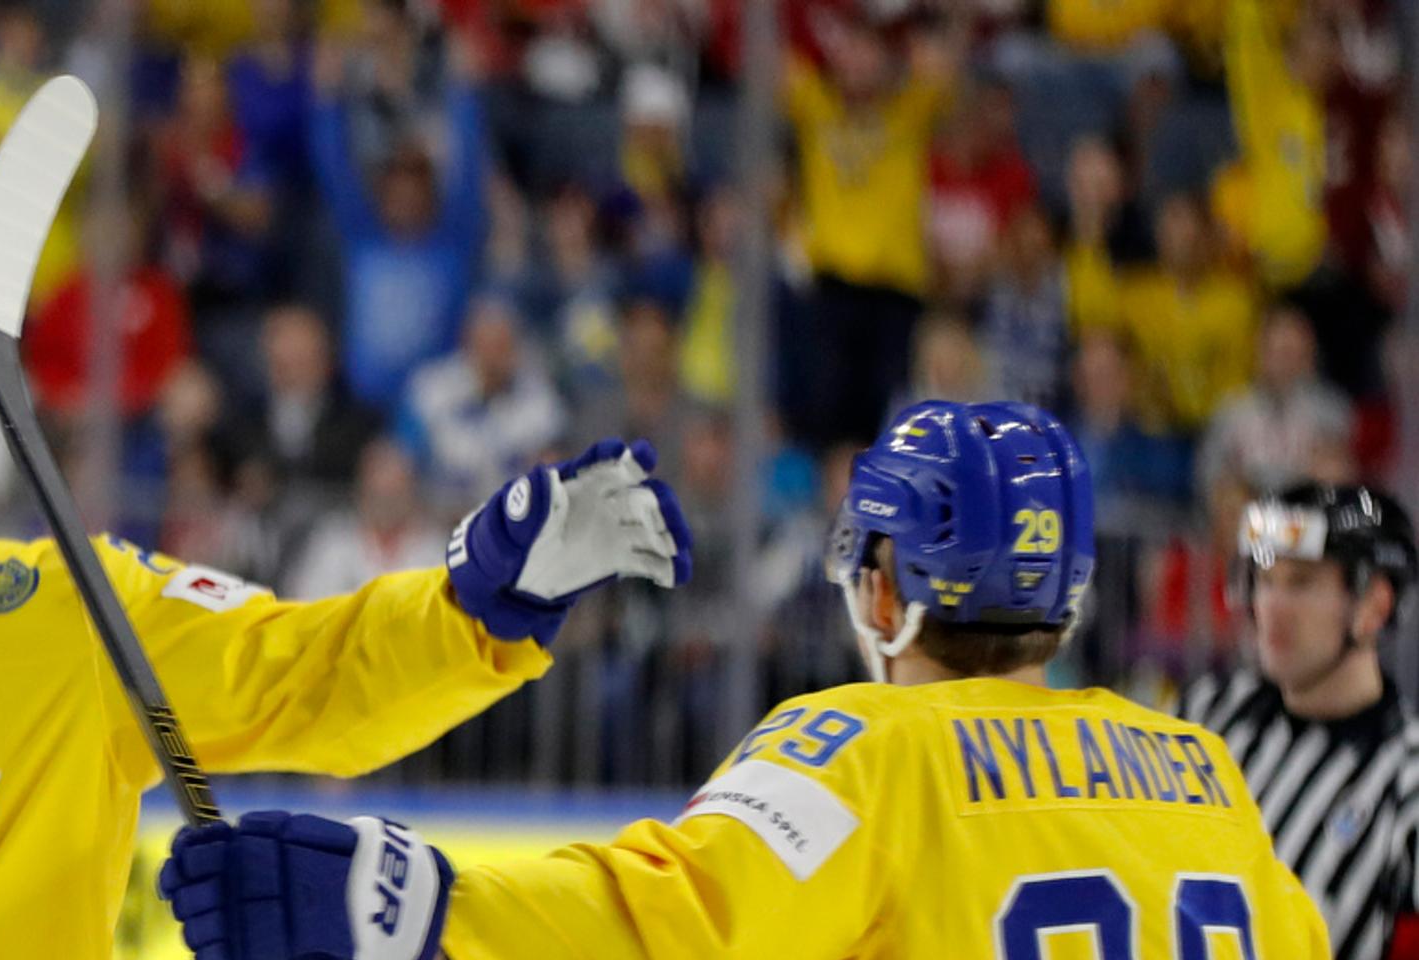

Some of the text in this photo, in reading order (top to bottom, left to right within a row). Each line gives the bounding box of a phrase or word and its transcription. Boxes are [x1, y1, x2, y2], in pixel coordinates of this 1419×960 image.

[1011, 508, 1063, 554] 29
[734, 708, 865, 768] 29
[952, 718, 1231, 808] NYLANDER
[770, 811, 810, 854] SPEL
